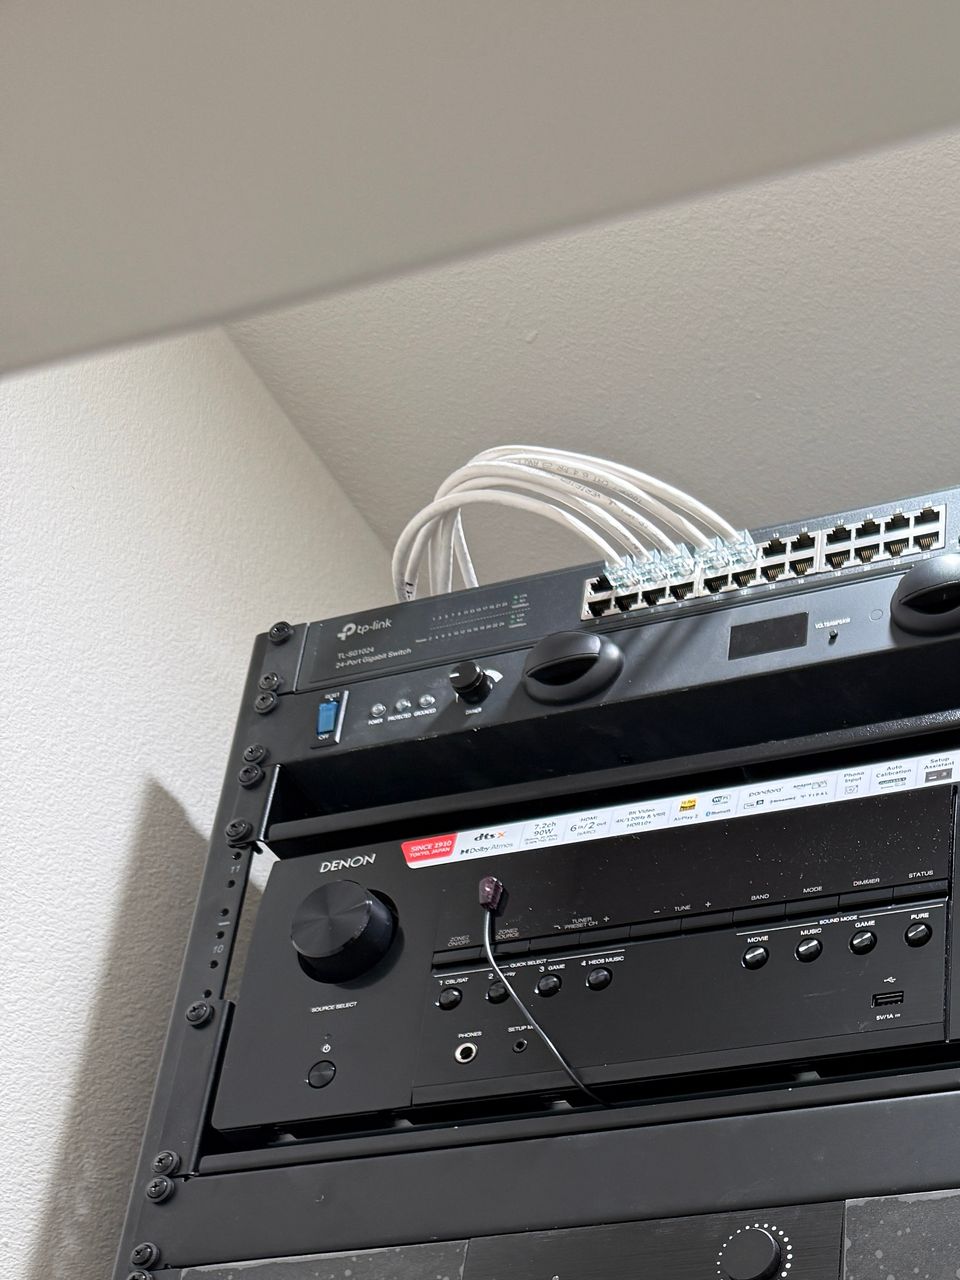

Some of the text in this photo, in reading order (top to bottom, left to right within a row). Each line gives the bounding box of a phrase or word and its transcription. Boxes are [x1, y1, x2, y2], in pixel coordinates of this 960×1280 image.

[356, 618, 392, 635] tp-link
[362, 651, 387, 665] Gigabit
[388, 648, 412, 660] Switch
[924, 761, 954, 770] Assistant
[875, 768, 912, 779] Calibration
[534, 821, 556, 829] 7.2ch
[469, 846, 490, 854] Dolby
[319, 853, 376, 873] DENON
[908, 870, 933, 878] STATUS
[853, 878, 880, 886] DIMMER
[855, 920, 875, 928] GAME
[311, 1004, 334, 1013] SOURCE
